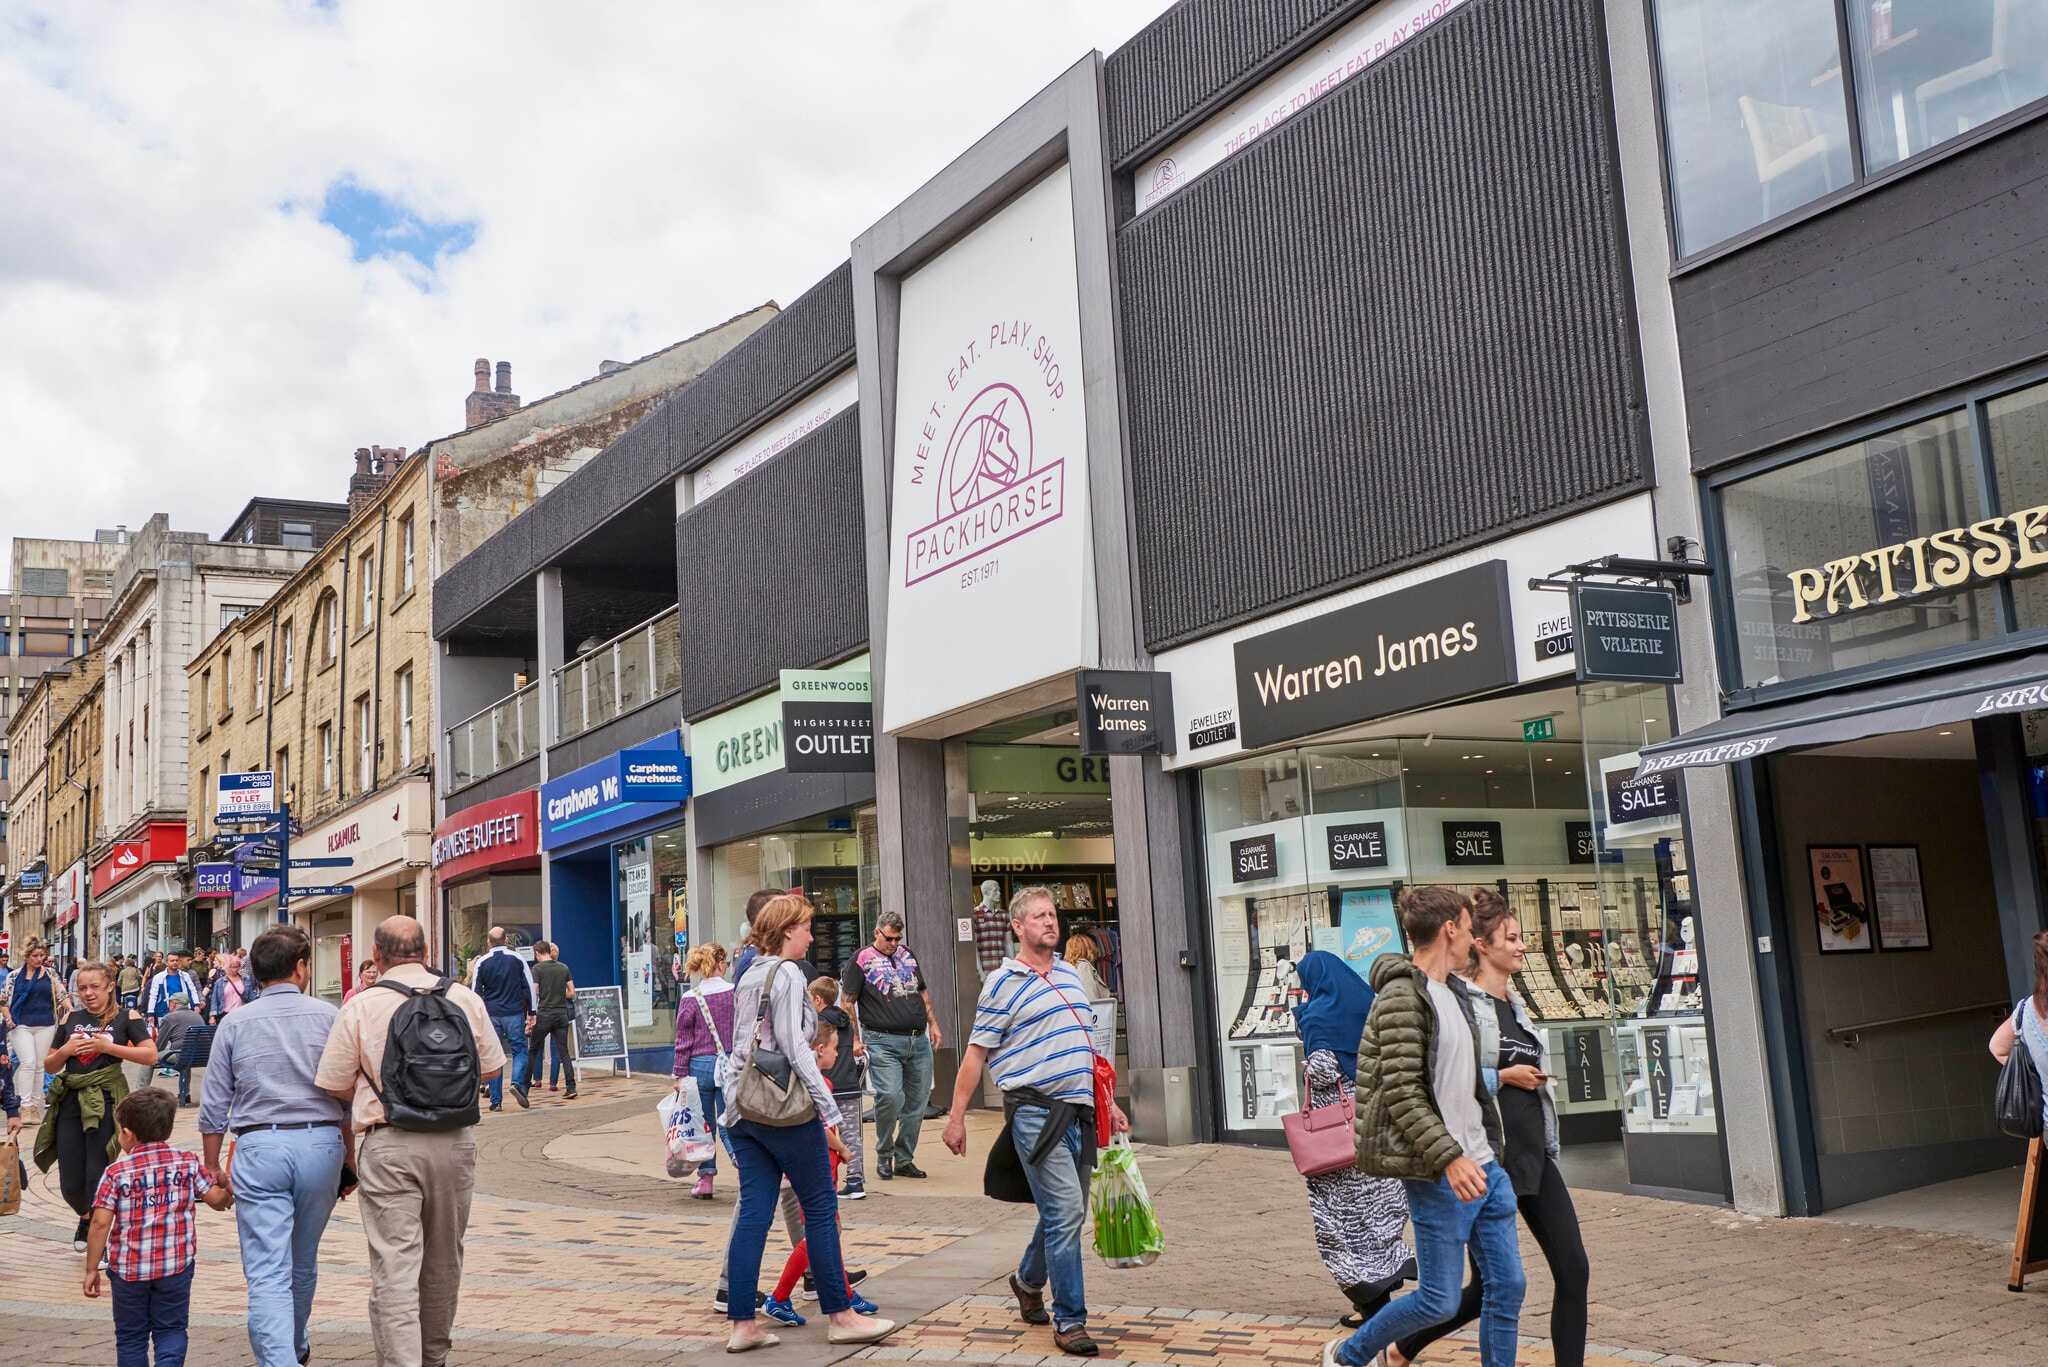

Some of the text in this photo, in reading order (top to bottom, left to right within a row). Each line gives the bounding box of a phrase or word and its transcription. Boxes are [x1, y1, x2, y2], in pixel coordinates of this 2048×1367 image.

[1224, 0, 1455, 156] THE PLACE TO MEET EAT PLAY SHOP
[734, 407, 832, 478] THE PLACE TO MEET EAT PLAY SHOP
[915, 476, 1053, 570] PACKHORSE
[1586, 609, 1670, 631] PATISSERIE
[1599, 635, 1664, 655] VALERIE
[1253, 620, 1479, 707] Warren James
[792, 681, 869, 691] GREENWOODS
[1090, 693, 1150, 712] Warren
[794, 719, 871, 727] HIGHSTREET
[1098, 714, 1147, 732] James
[1189, 709, 1233, 732] JEWELLERY
[716, 719, 784, 773] GREEN
[795, 735, 871, 755] OUTLET
[1196, 728, 1229, 746] OUTLET
[1640, 736, 1778, 775] BREAKFAST
[240, 774, 271, 783] jackson
[625, 774, 683, 783] Warehouse
[629, 764, 678, 775] Carphone
[252, 780, 271, 788] criss
[230, 795, 242, 803] TO
[548, 784, 599, 822] Carphone
[1621, 785, 1667, 811] SALE
[473, 813, 520, 851] BUFFET
[1334, 831, 1378, 842] CLEARANCE
[1240, 844, 1266, 856] CLEARANCE
[1333, 841, 1382, 861] SALE
[1455, 840, 1493, 856] SALE
[1240, 853, 1268, 873] SALE
[199, 871, 231, 885] card
[635, 870, 641, 880] AN
[199, 884, 231, 892] market
[1348, 894, 1385, 908] SALE
[589, 1007, 608, 1015] FOR
[584, 1015, 614, 1030] £24
[1579, 1036, 1592, 1100] SALE
[1244, 1056, 1253, 1118] SALE
[1652, 1039, 1668, 1117] SALE
[120, 1171, 194, 1198] COLLEGE
[134, 1191, 177, 1210] CASUAL
